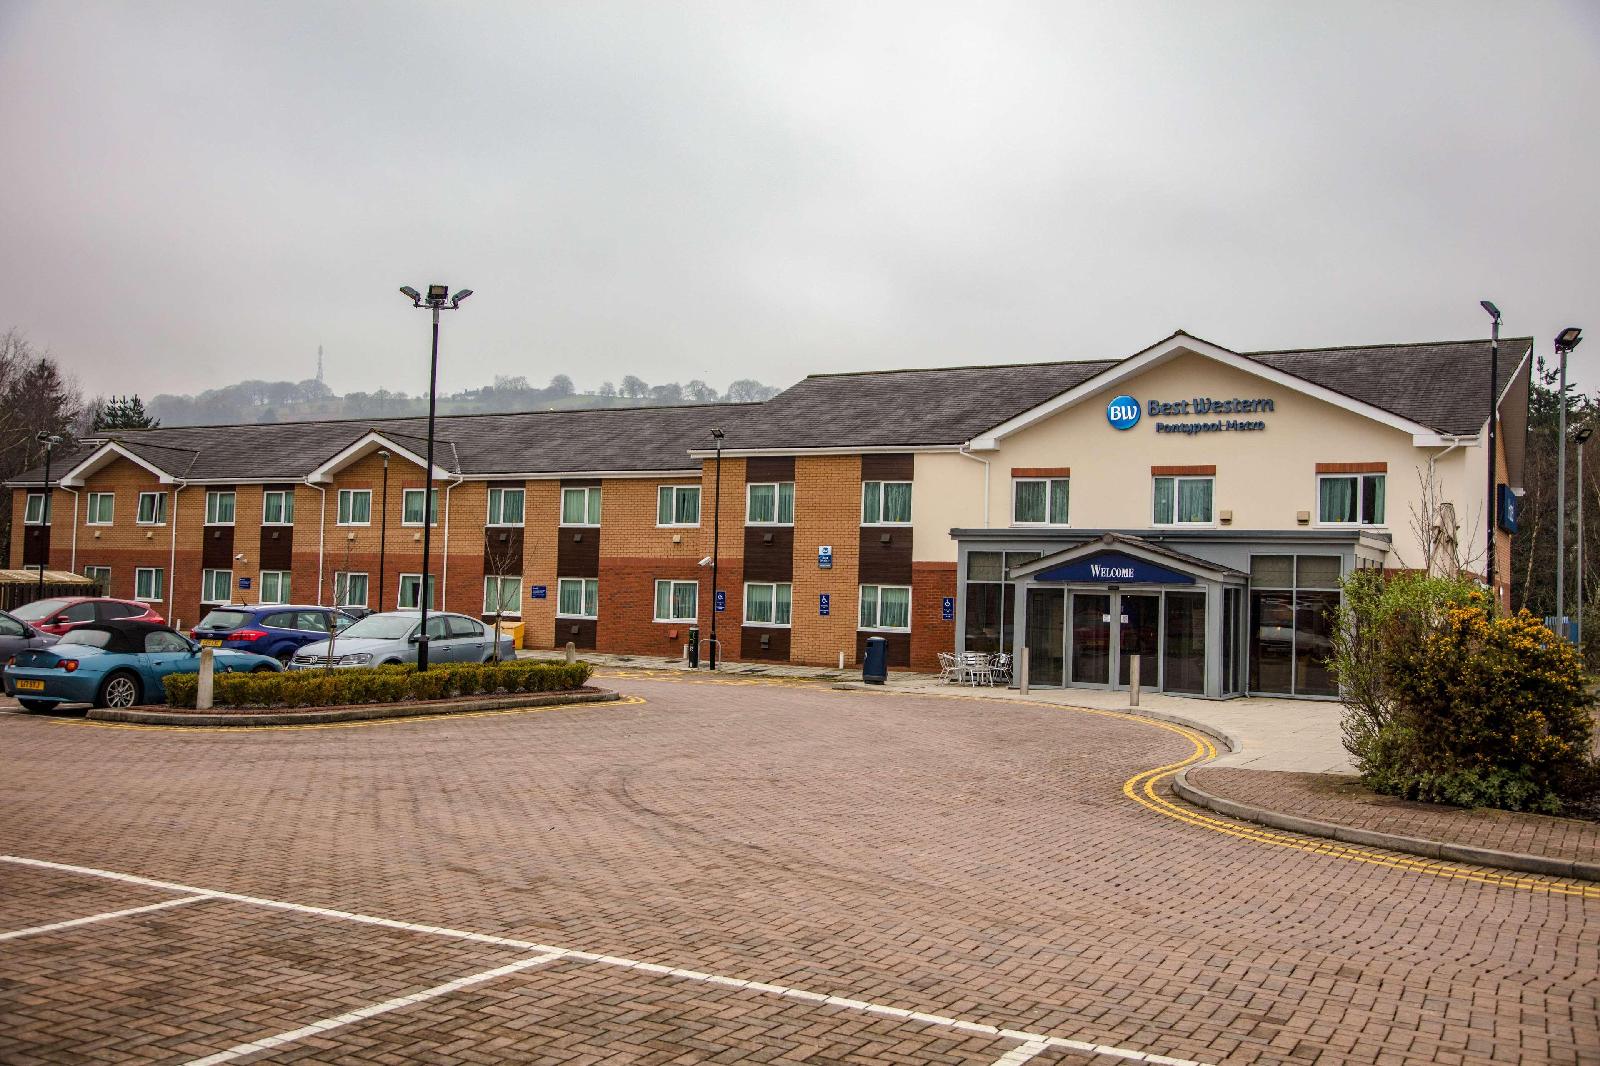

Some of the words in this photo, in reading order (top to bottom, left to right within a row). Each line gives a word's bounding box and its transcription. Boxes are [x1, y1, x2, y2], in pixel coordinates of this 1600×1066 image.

[1111, 406, 1137, 421] BW
[1147, 400, 1189, 416] Best
[1193, 398, 1274, 414] Western
[1156, 420, 1222, 435] Pontypool
[1226, 419, 1265, 431] Metro
